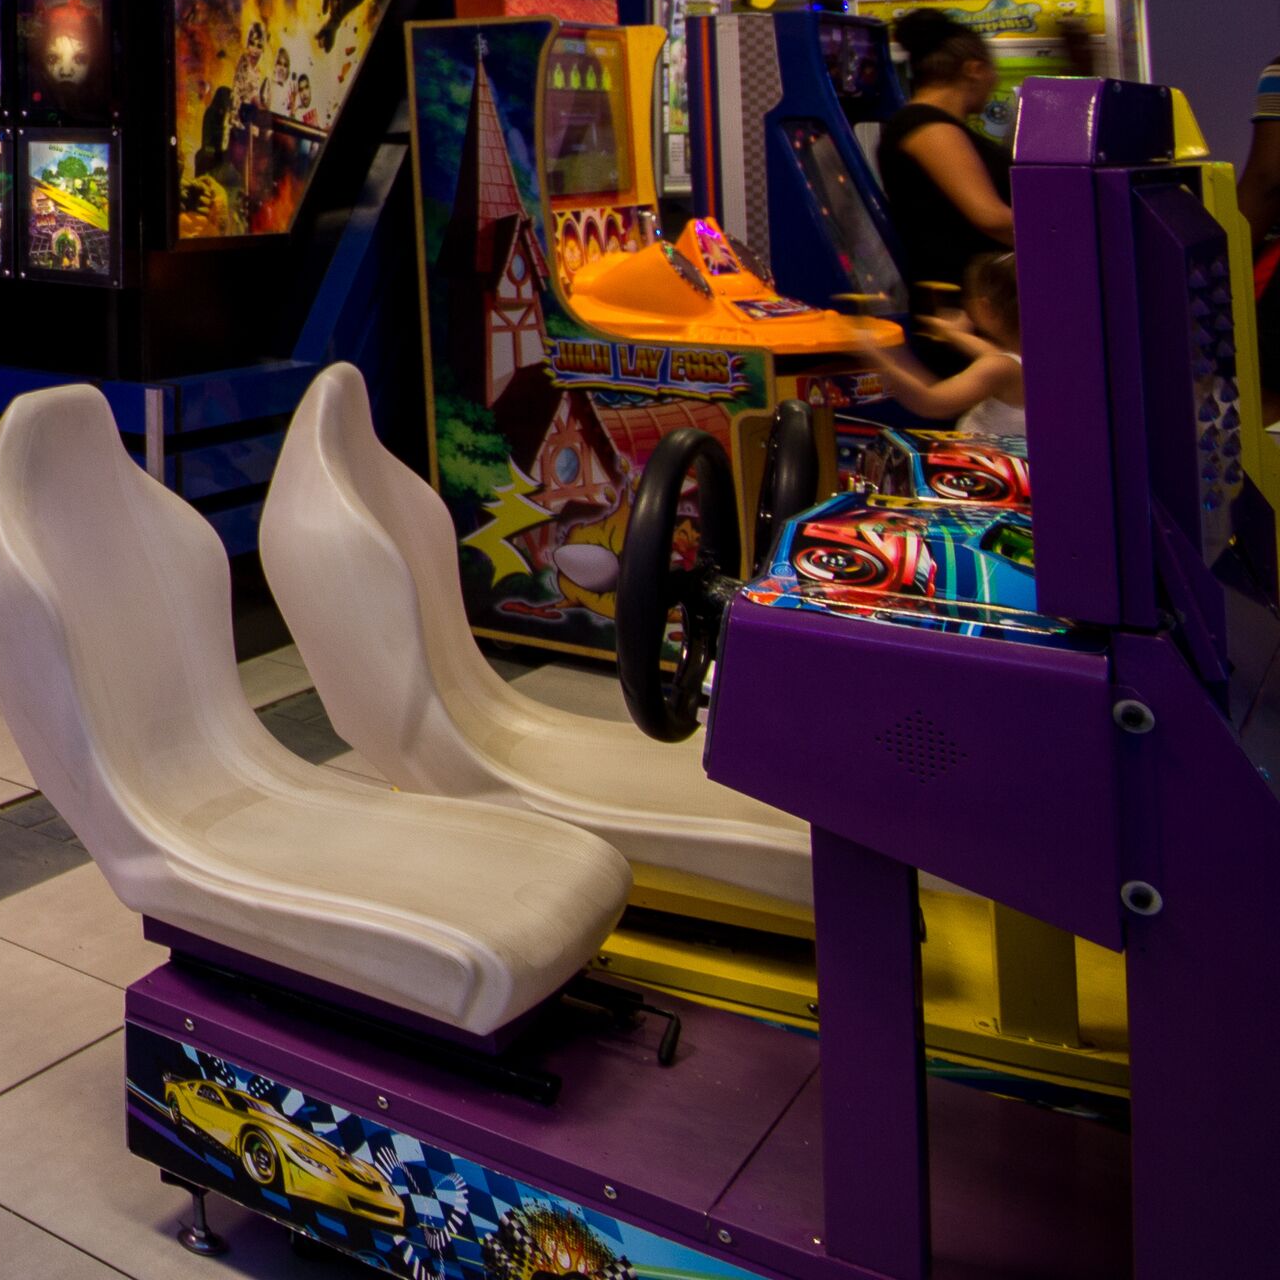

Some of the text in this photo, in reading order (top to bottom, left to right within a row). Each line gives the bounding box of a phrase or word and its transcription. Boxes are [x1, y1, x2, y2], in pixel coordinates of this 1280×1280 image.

[555, 341, 730, 384] JINJI LAY EGGS
